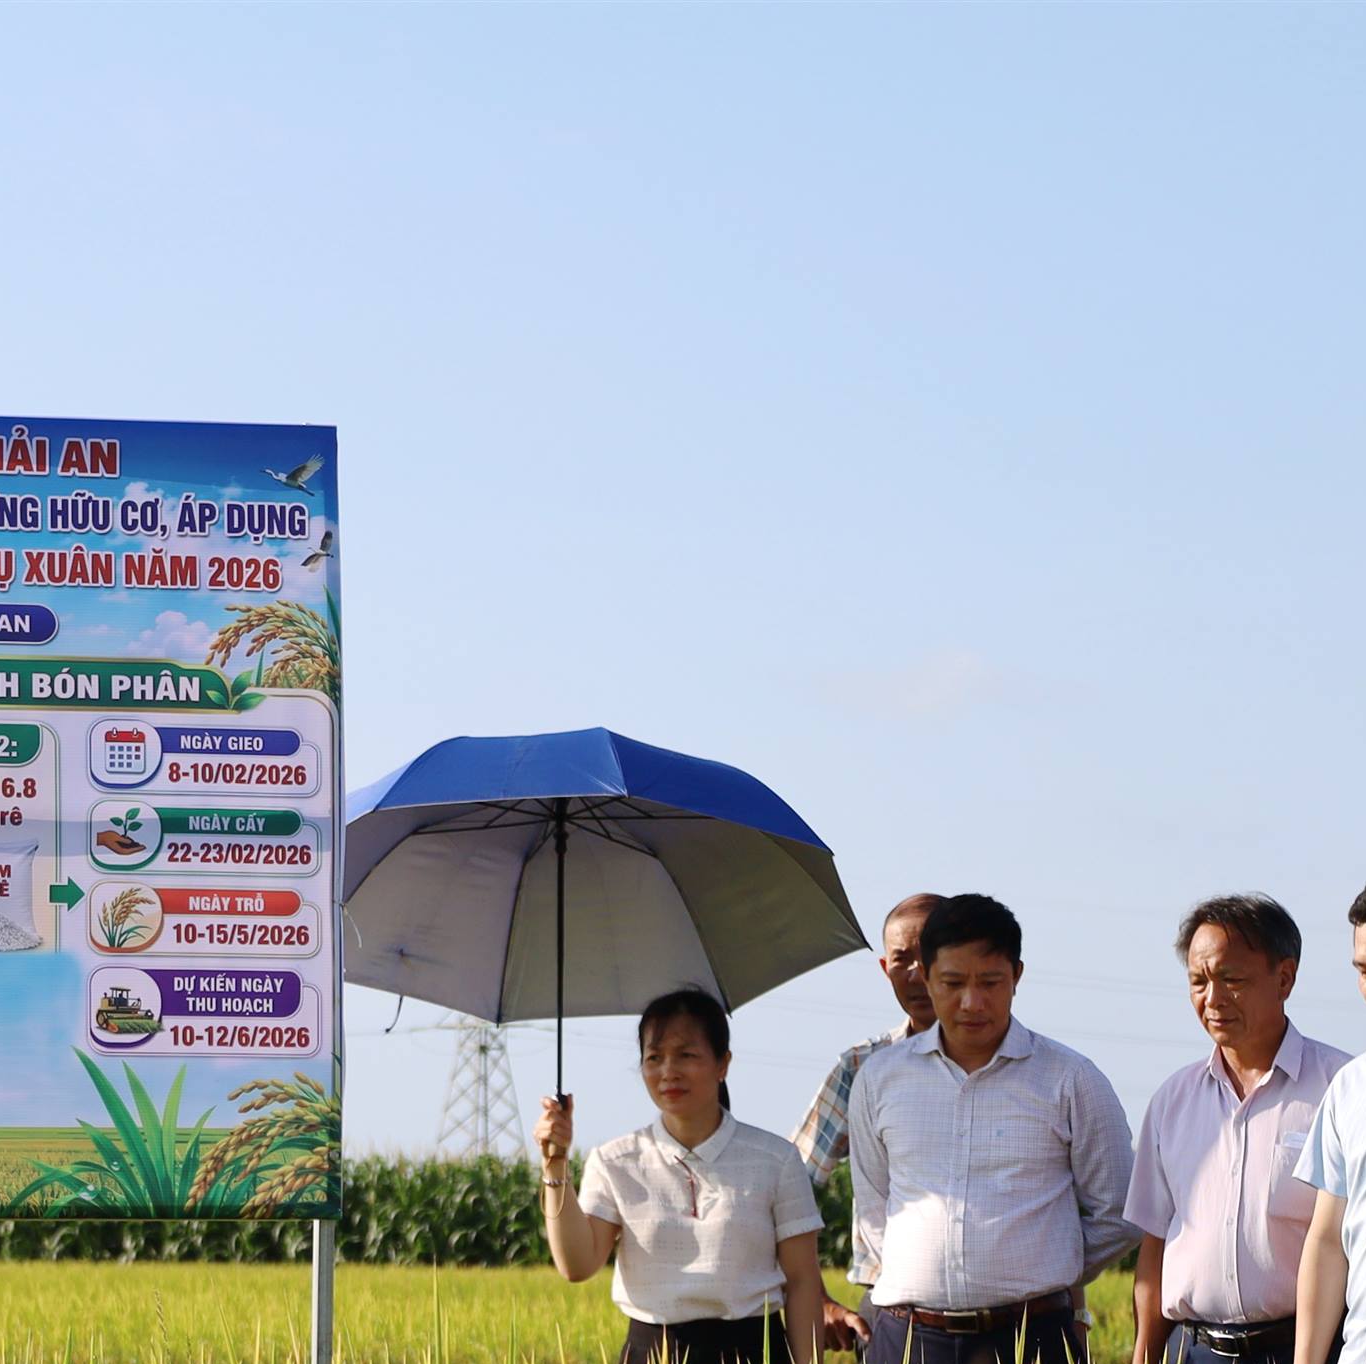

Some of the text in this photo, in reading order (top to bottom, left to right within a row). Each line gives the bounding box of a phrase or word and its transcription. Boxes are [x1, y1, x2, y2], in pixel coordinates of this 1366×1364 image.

[60, 440, 118, 475] AN
[50, 494, 110, 532] HỮU
[121, 498, 168, 536] CƠ,
[177, 494, 217, 534] ÁP
[227, 503, 307, 542] DỤNG
[24, 546, 114, 587] XUÂN
[125, 547, 198, 587] NĂM
[208, 557, 281, 590] 2026
[34, 667, 97, 700] BÓN
[111, 670, 200, 702] PHÂN
[180, 732, 263, 751] NGÀY GIEO
[168, 763, 306, 785] 8-10/02/2026
[189, 813, 266, 832] NGÀY CẤY
[167, 842, 312, 864] 22-23/02/2026
[189, 893, 265, 912] NGÀY TRỖ
[173, 923, 309, 945] 10-15/5/2026
[174, 973, 283, 994] DỰ KIẾN NGÀY
[186, 997, 273, 1015] THU HOẠCH
[170, 1025, 310, 1047] 10-12/6/2026
